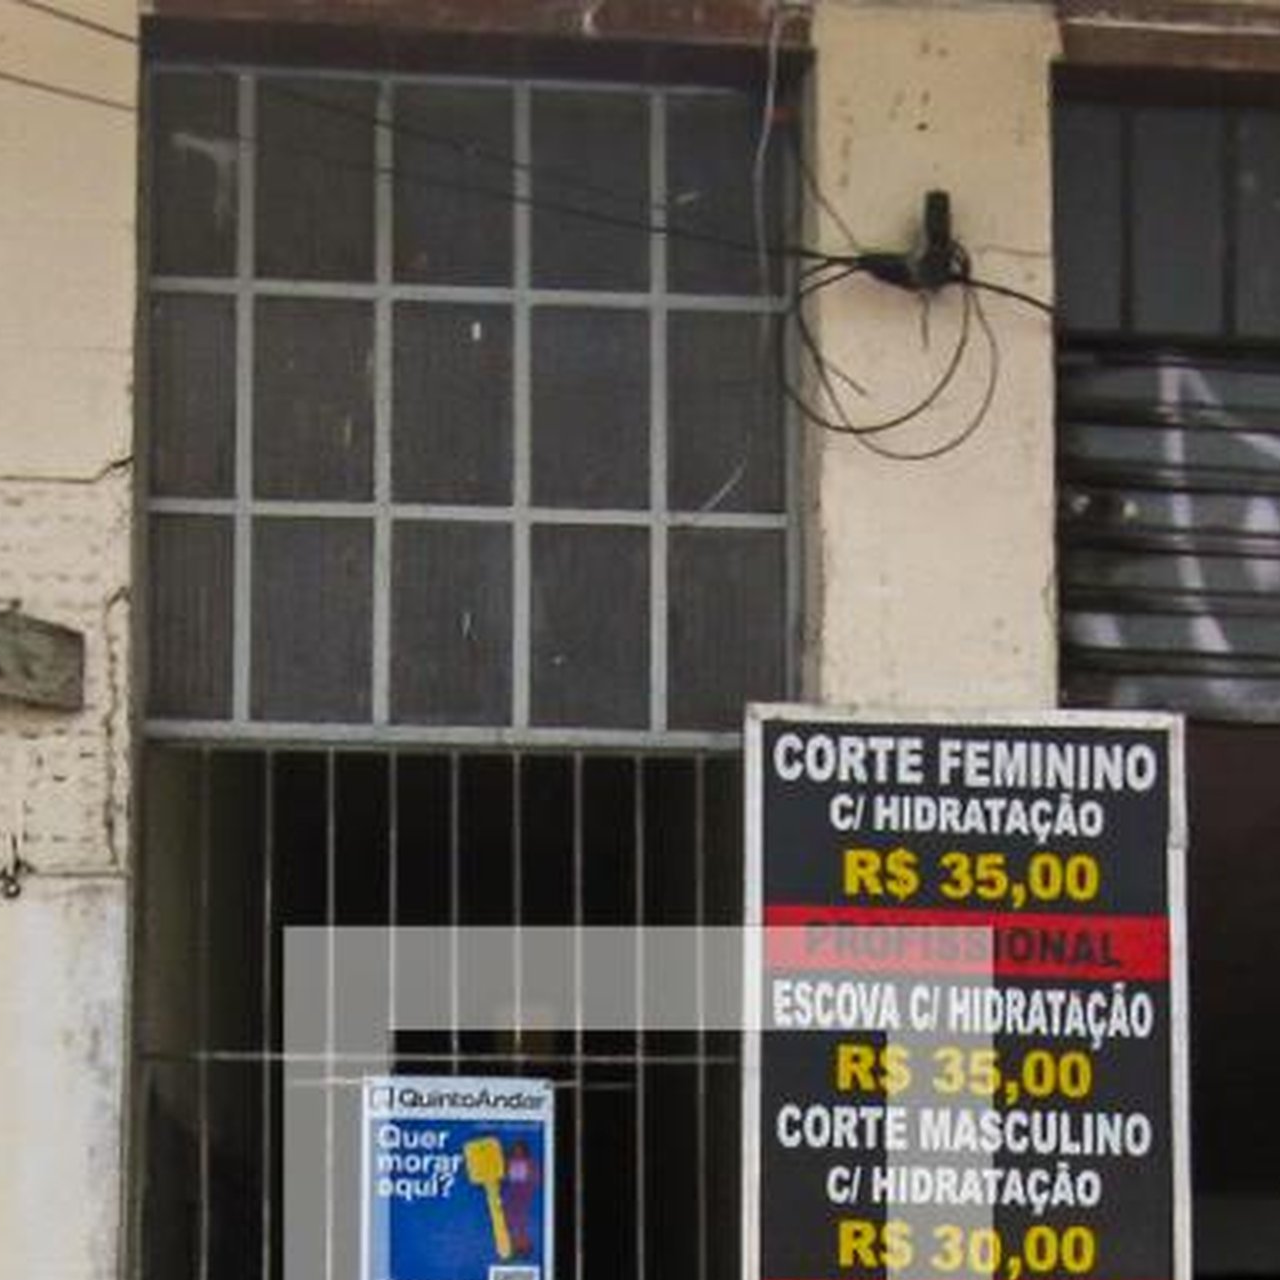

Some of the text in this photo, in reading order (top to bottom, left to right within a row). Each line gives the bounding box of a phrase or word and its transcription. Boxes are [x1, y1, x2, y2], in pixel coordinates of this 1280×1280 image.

[773, 733, 1157, 791] CORTE FEMININO
[829, 793, 1105, 842] C/ HIDRATAÇÃO
[842, 847, 1101, 910] R$ 35,00
[803, 919, 1122, 968] PROFISSIONAL
[773, 980, 1154, 1049] ESCOVA C/ HIDRATAÇÃO
[399, 1087, 546, 1110] QuintoAndar
[835, 1043, 1092, 1104] R$ 35,00
[378, 1123, 450, 1149] Quer
[775, 1104, 1152, 1156] CORTE MASCULINO
[377, 1151, 463, 1174] morar
[826, 1162, 1102, 1214] C/ HIDRATAÇÃO
[837, 1219, 914, 1271] R$
